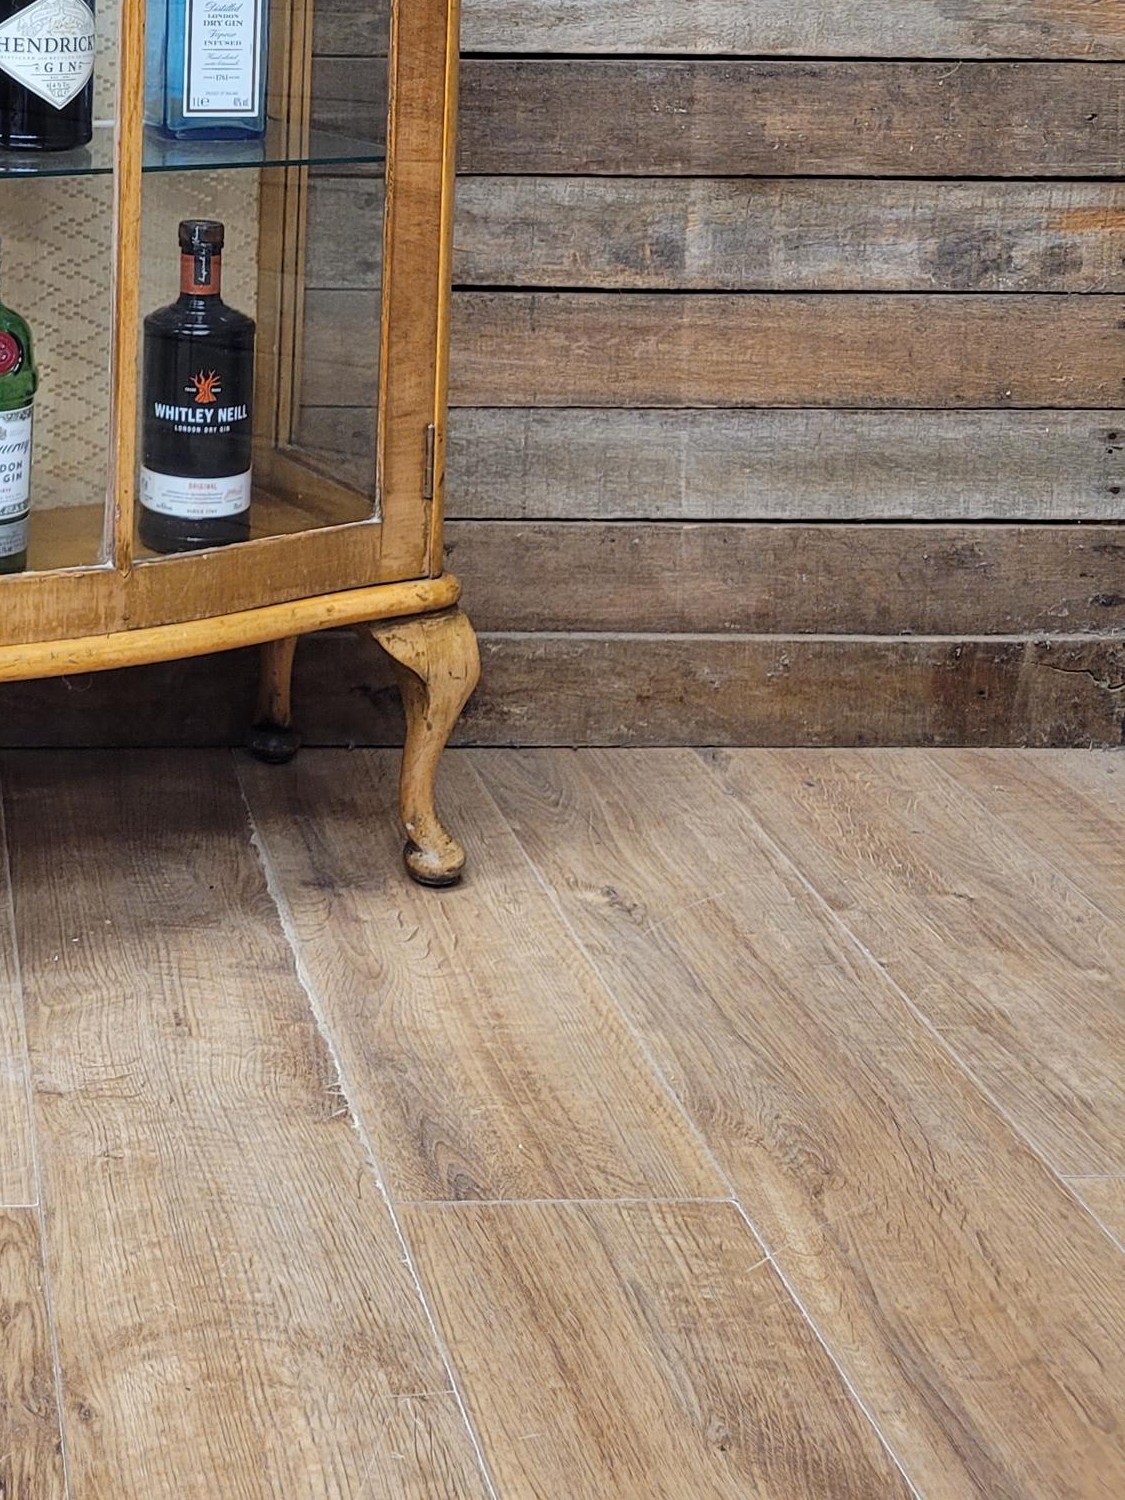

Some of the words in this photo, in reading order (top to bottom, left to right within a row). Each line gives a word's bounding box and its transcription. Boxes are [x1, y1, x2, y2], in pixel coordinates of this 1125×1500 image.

[44, 61, 76, 73] GIN
[155, 402, 214, 424] WHITLEY
[218, 404, 247, 423] NEILL
[174, 425, 202, 433] LONDON
[204, 426, 217, 434] DRY
[3, 472, 22, 483] GIN
